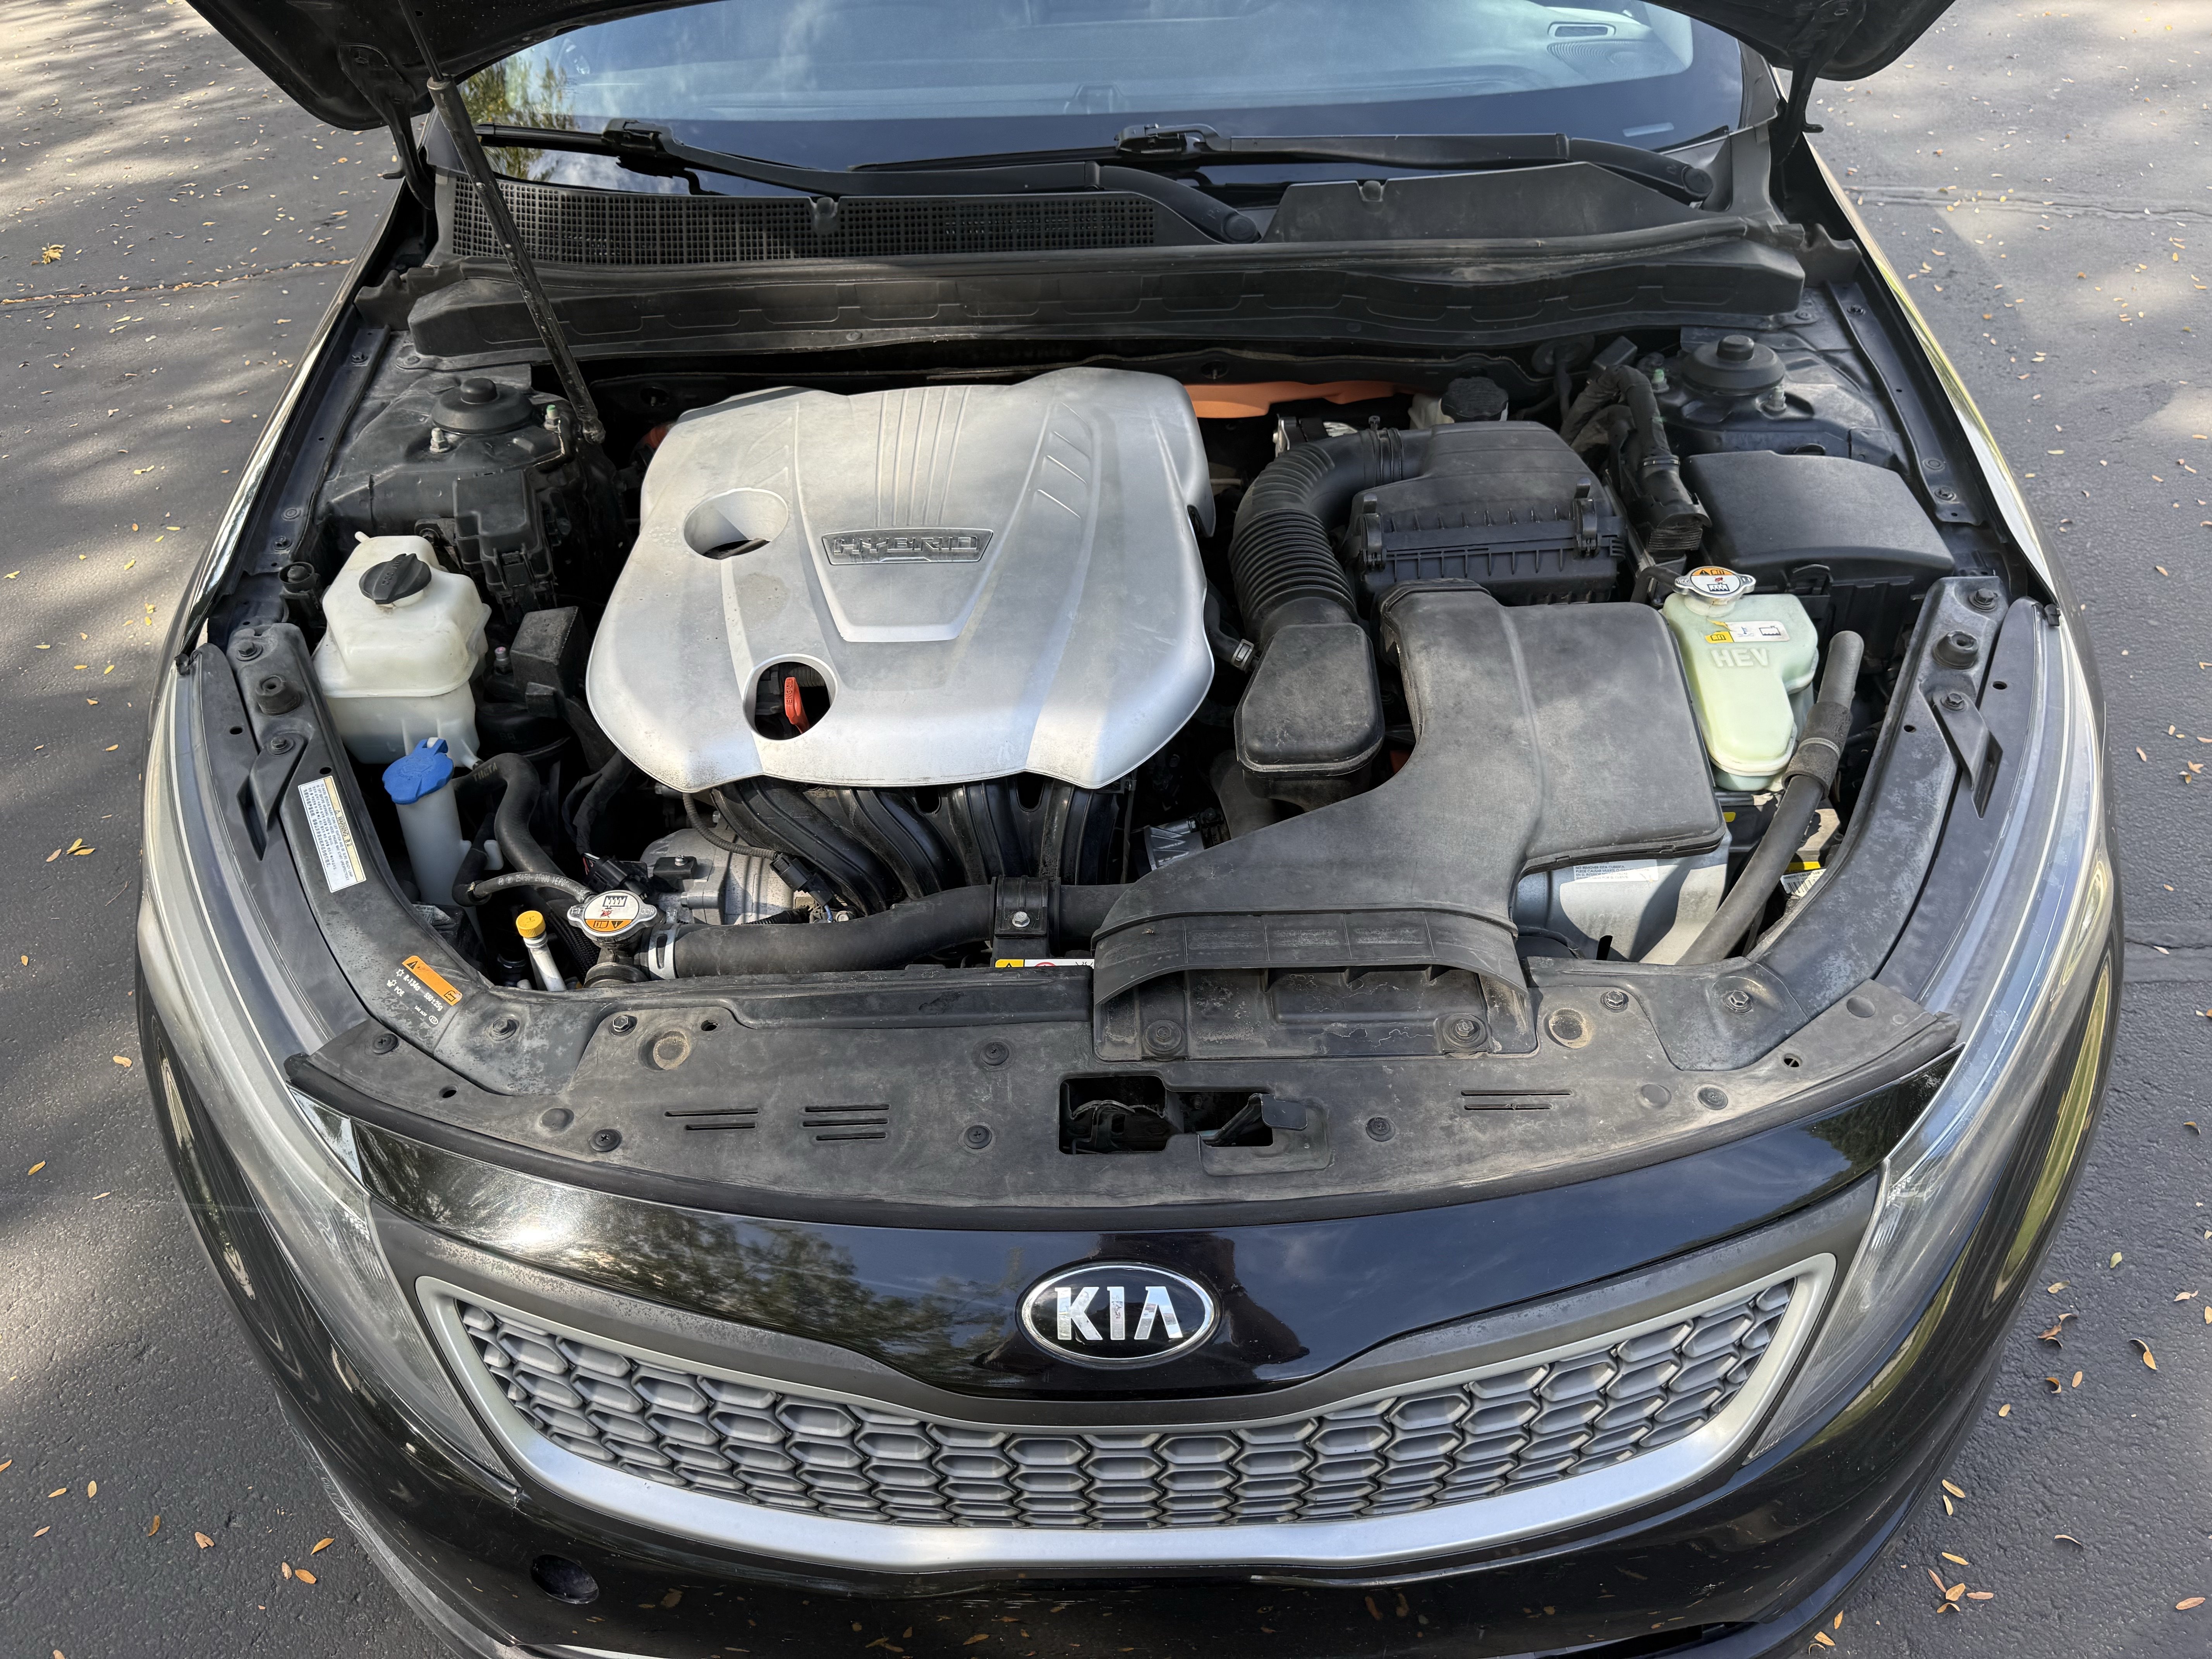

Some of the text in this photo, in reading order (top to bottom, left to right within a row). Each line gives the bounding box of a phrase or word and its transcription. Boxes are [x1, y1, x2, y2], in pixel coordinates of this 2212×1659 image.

[833, 536, 977, 555] HYBRID
[1711, 648, 1768, 667] HEV
[337, 816, 349, 837] WARNING
[394, 986, 405, 997] POE
[403, 974, 421, 991] R-134a
[1054, 1286, 1183, 1340] KIA
